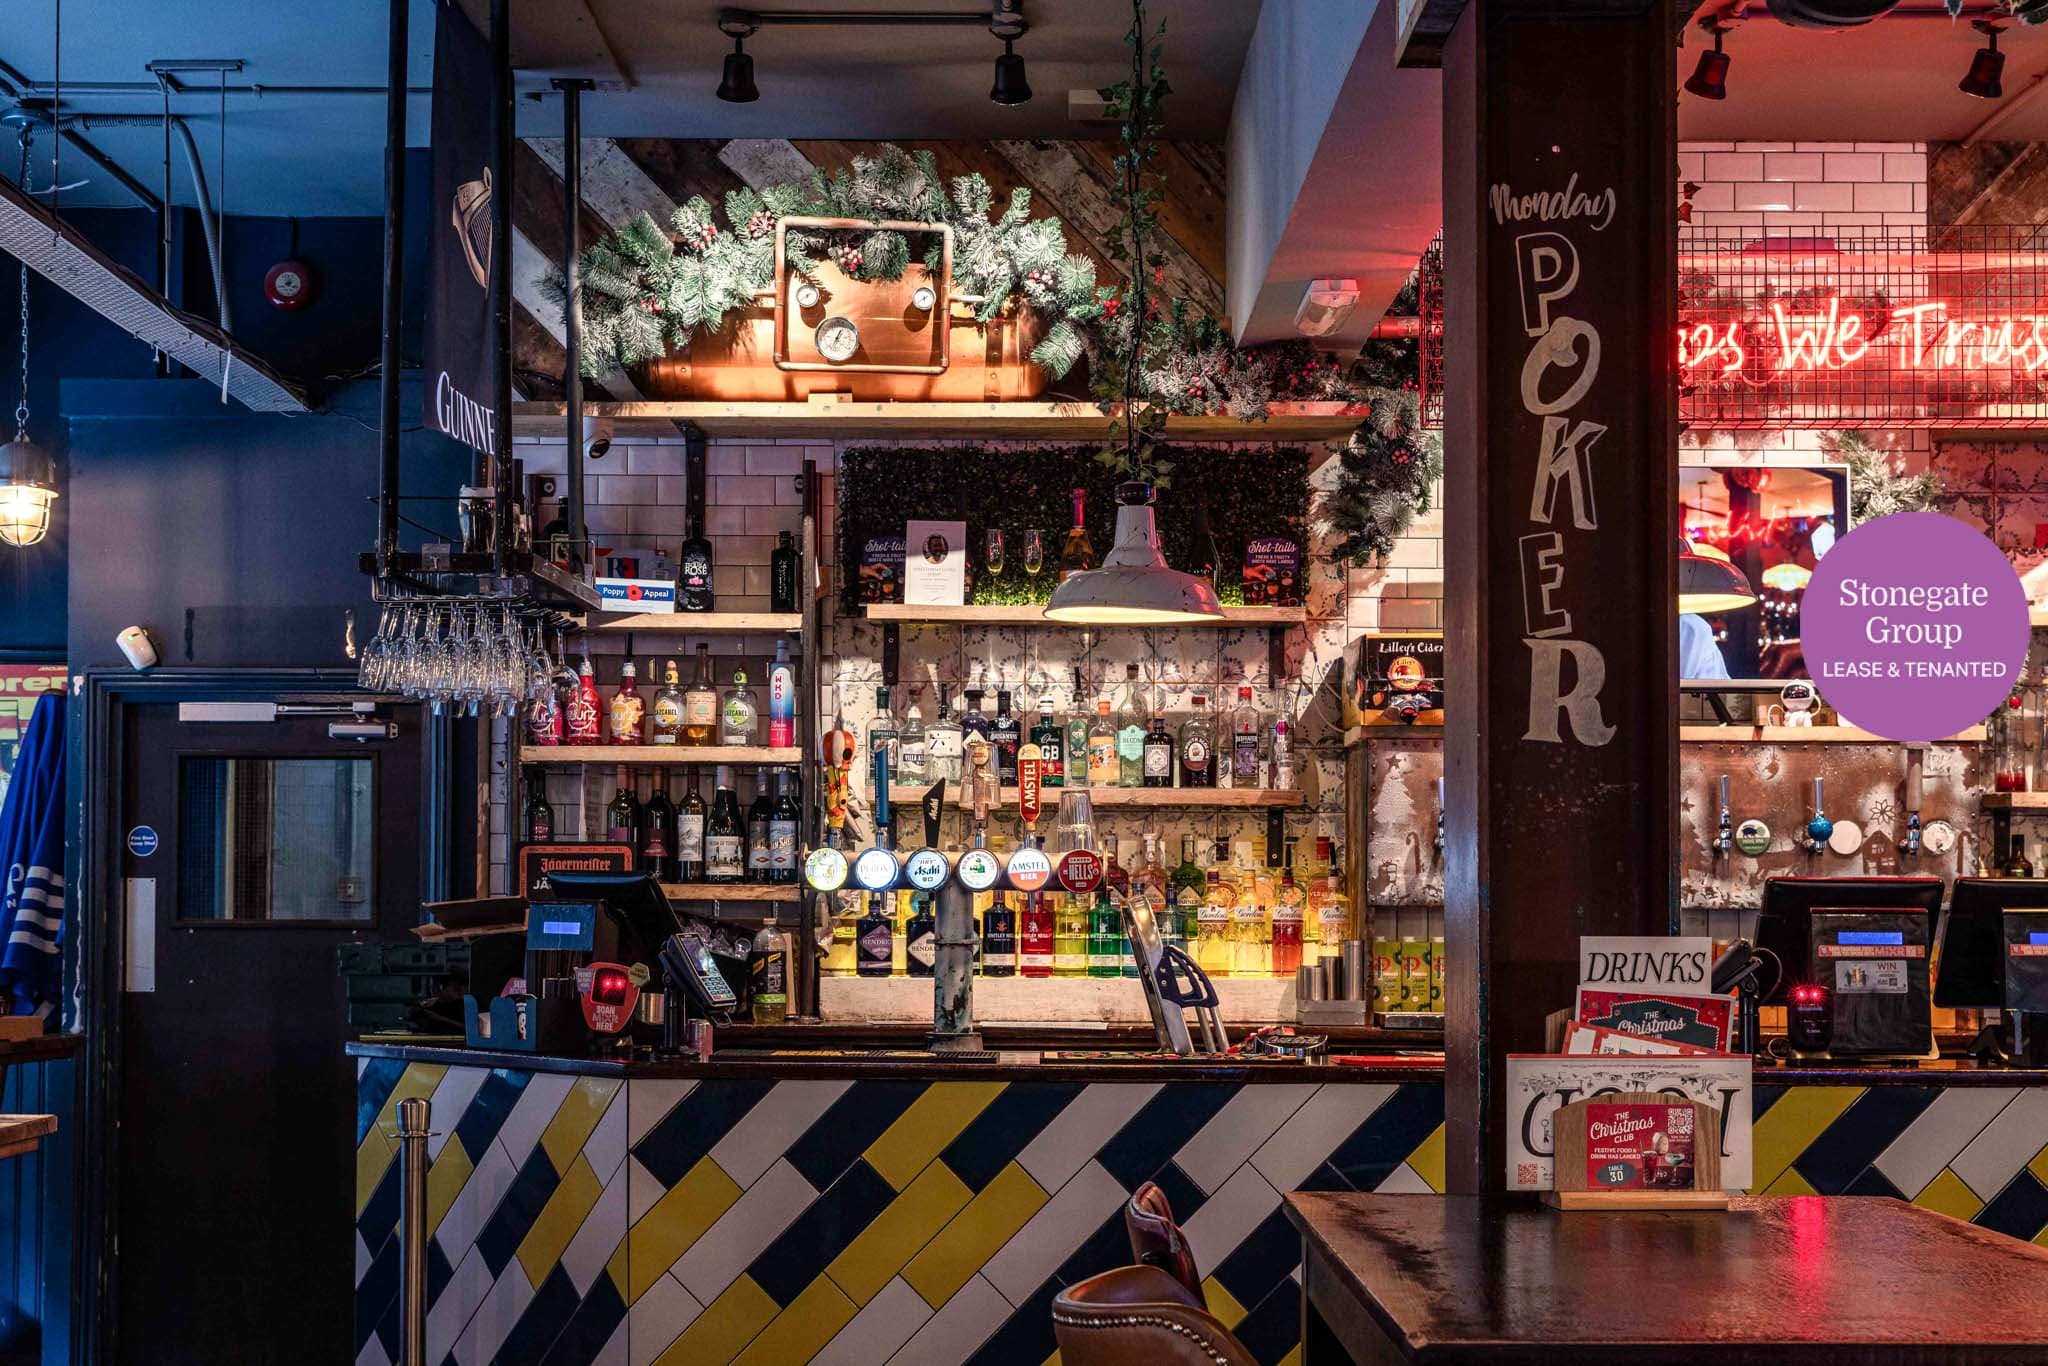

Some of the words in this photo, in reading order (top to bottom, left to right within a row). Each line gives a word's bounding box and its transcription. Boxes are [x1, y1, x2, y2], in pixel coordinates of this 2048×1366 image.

[1489, 172, 1616, 231] Monday
[1772, 297, 1869, 374] We
[1891, 302, 2048, 373] Trus
[436, 371, 494, 455] GUINNE
[1515, 231, 1617, 747] POKER
[865, 540, 906, 553] Shot-tail
[1248, 541, 1297, 553] Shot-tails
[685, 567, 708, 576] ROSE
[603, 587, 625, 597] Poppy
[644, 590, 669, 599] Appeal
[1380, 641, 1415, 656] Lilley's
[1041, 745, 1059, 760] GB
[1024, 761, 1036, 809] AMSTEL
[914, 864, 940, 877] Asahi
[1011, 862, 1046, 871] AMSTEL
[1068, 863, 1094, 880] HELLS
[1020, 872, 1038, 881] BIER
[1584, 952, 1707, 984] DRINKS
[1877, 962, 1897, 970] WIN
[1645, 1011, 1659, 1019] THE
[595, 1021, 613, 1031] HERE
[1617, 1017, 1686, 1035] Christmas
[1615, 1111, 1630, 1121] THE
[1590, 1116, 1656, 1140] Christmas
[1614, 1133, 1635, 1144] CLUB
[1610, 1170, 1624, 1182] 30
